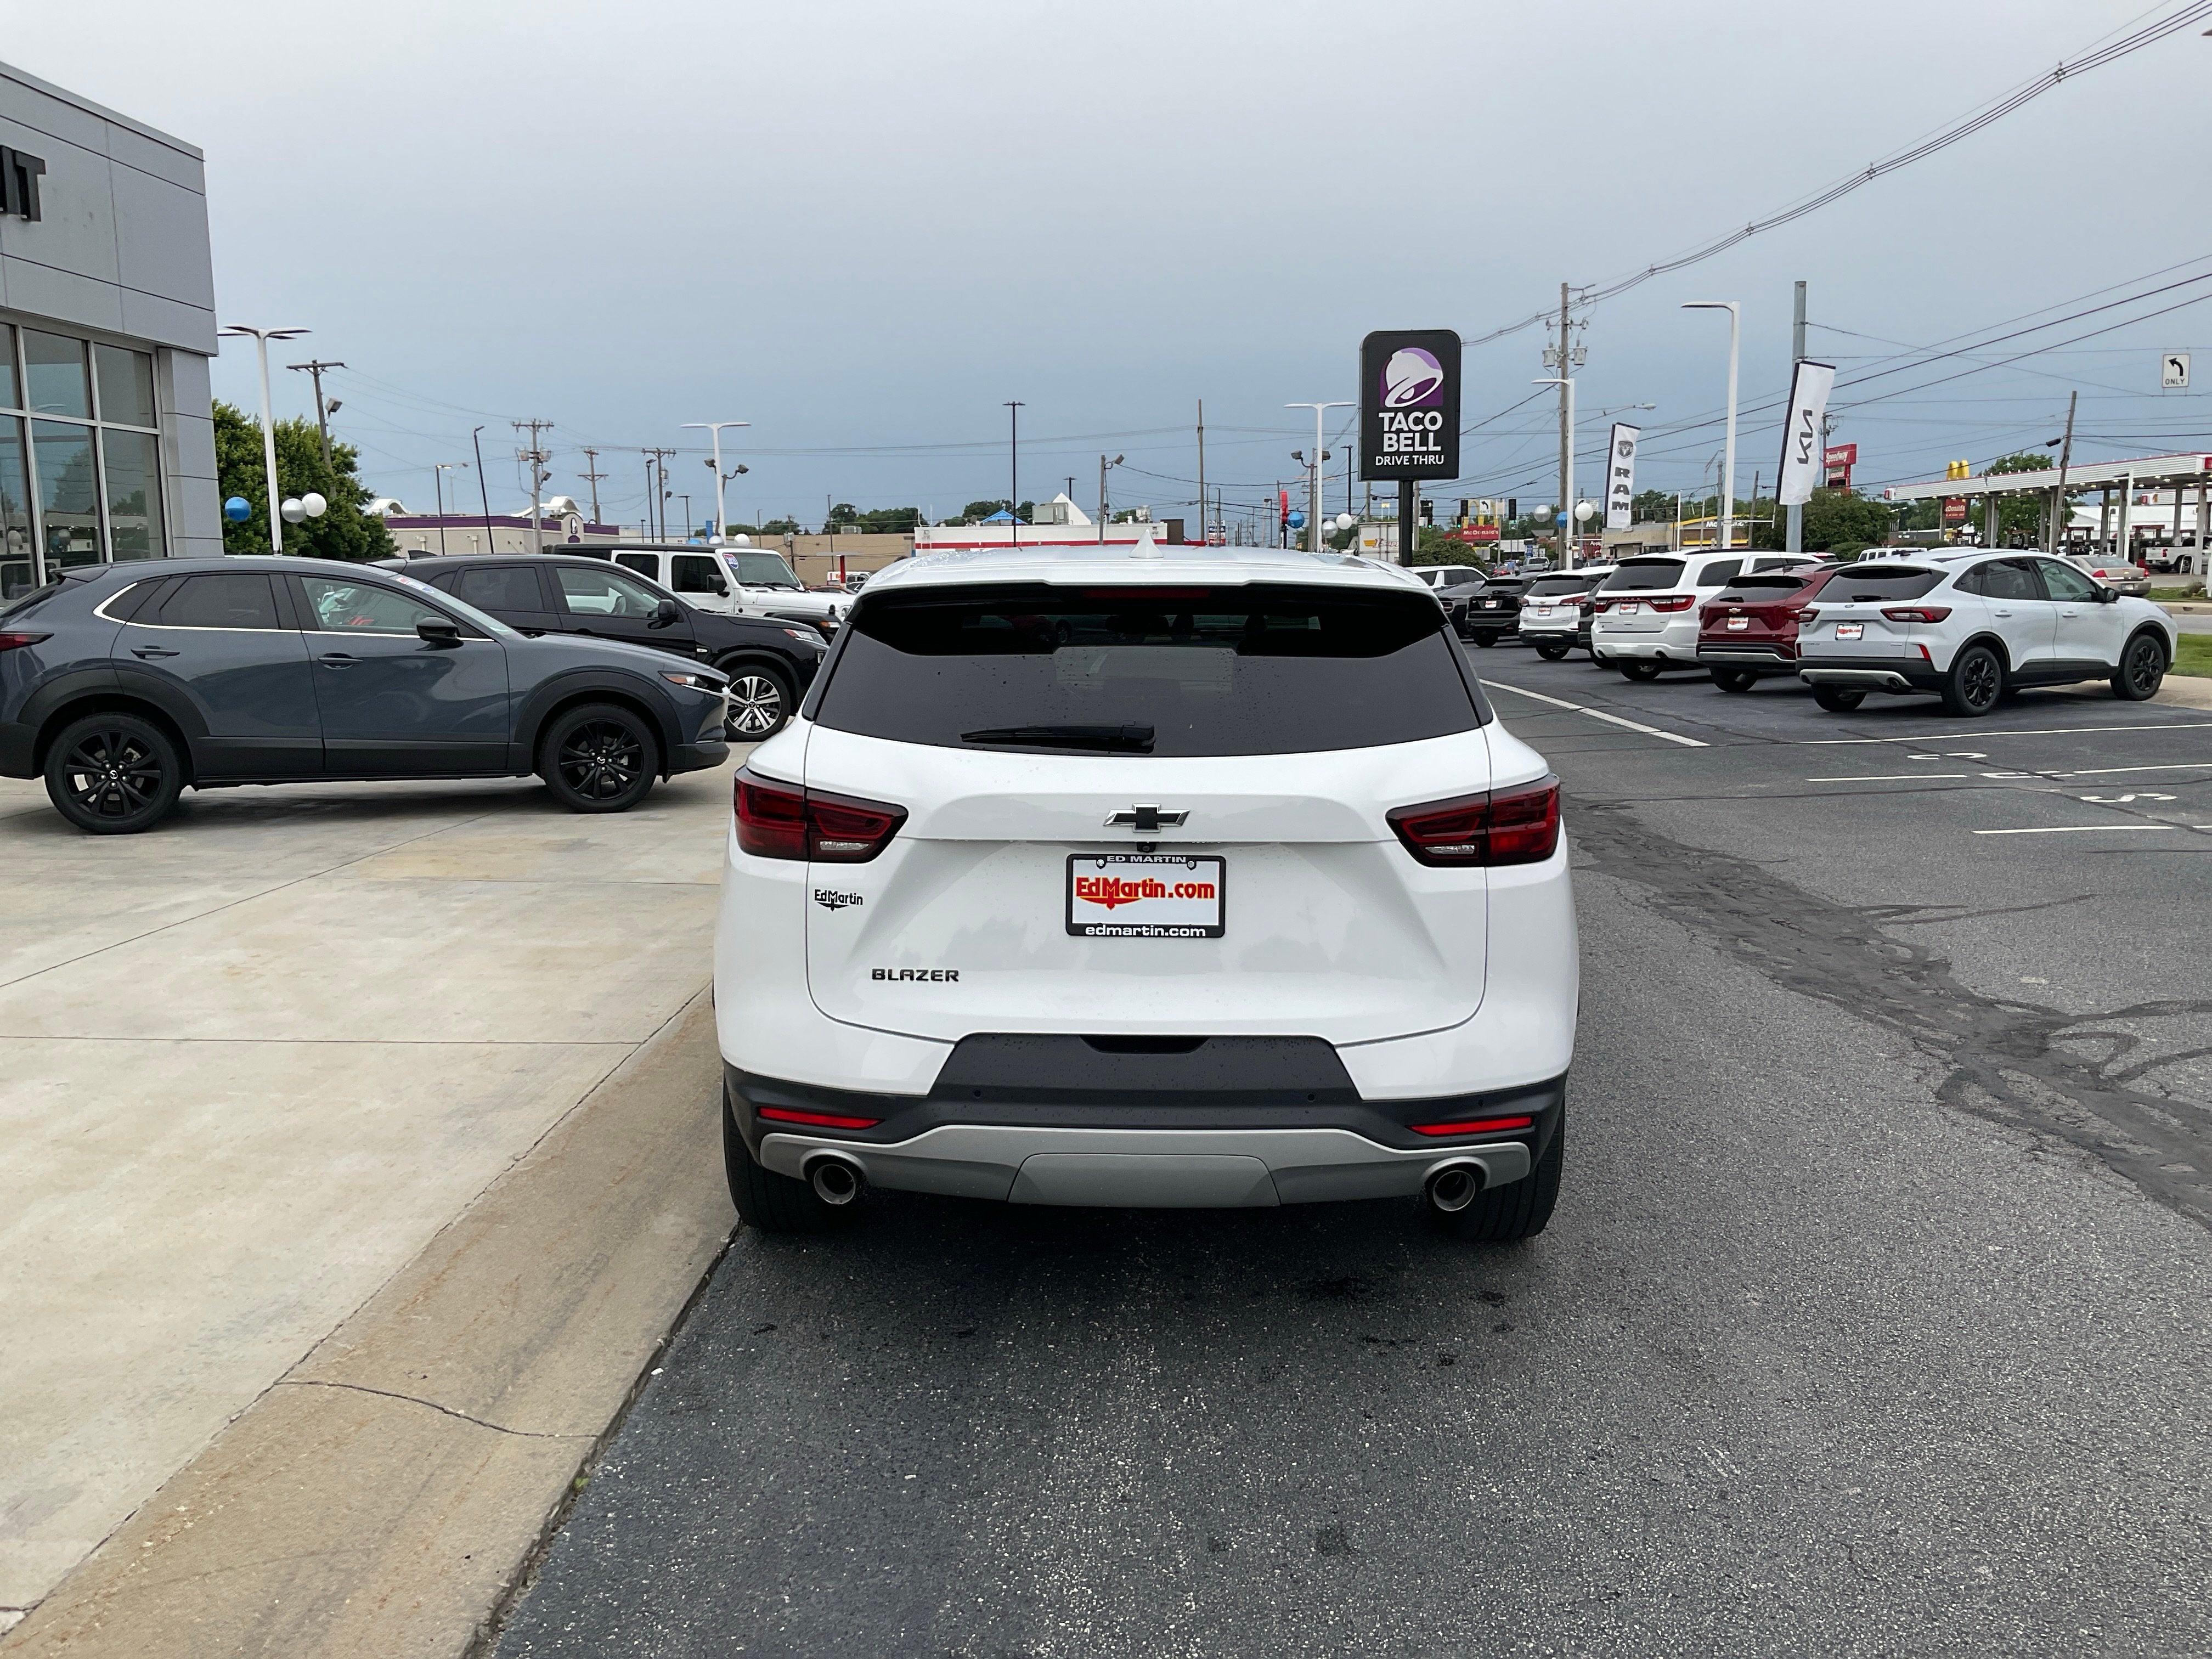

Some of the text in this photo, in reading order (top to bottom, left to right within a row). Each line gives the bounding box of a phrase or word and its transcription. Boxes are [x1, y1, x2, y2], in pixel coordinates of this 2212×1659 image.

[1379, 411, 1442, 431] TACO
[1383, 432, 1441, 452] BELL
[1375, 455, 1444, 465] DRIVE THRU
[1826, 451, 1848, 465] Speedway
[1612, 467, 1630, 510] RAM
[814, 889, 863, 907] EdMartin
[1076, 877, 1215, 903] EdMartin.com
[1085, 924, 1206, 936] edmartin.com
[872, 968, 959, 981] BLAZER
